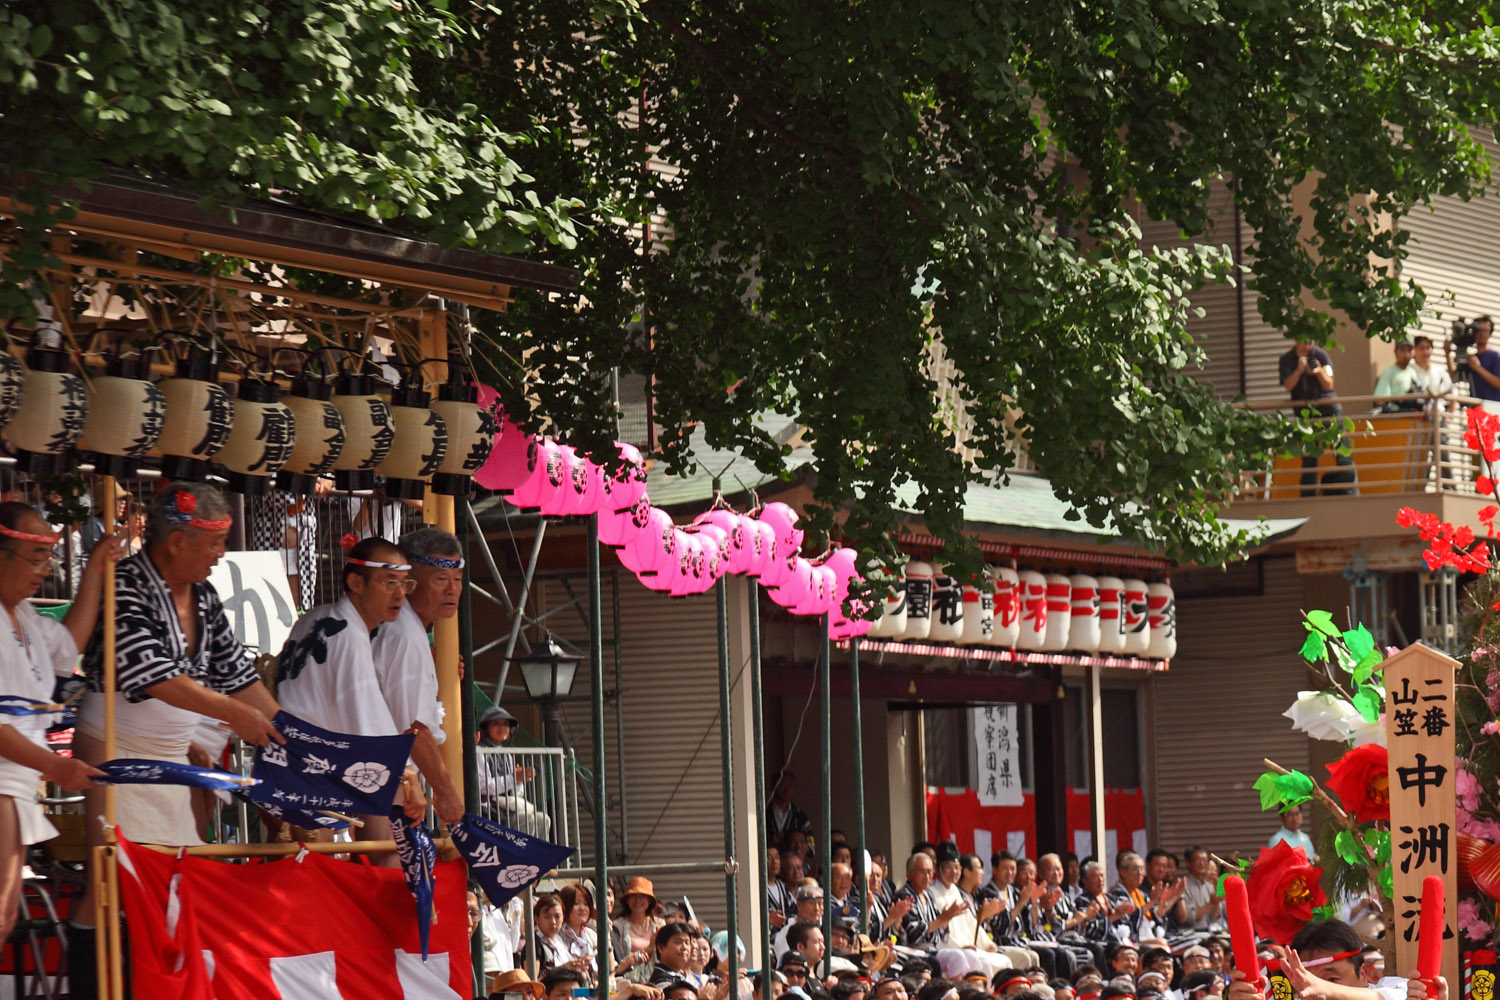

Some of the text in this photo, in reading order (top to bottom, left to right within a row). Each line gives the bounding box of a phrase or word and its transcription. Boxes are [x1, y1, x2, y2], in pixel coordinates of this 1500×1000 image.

[248, 406, 295, 474] 顧問
[222, 560, 293, 656] か
[1391, 678, 1419, 737] 山笠
[1420, 679, 1450, 737] 二番
